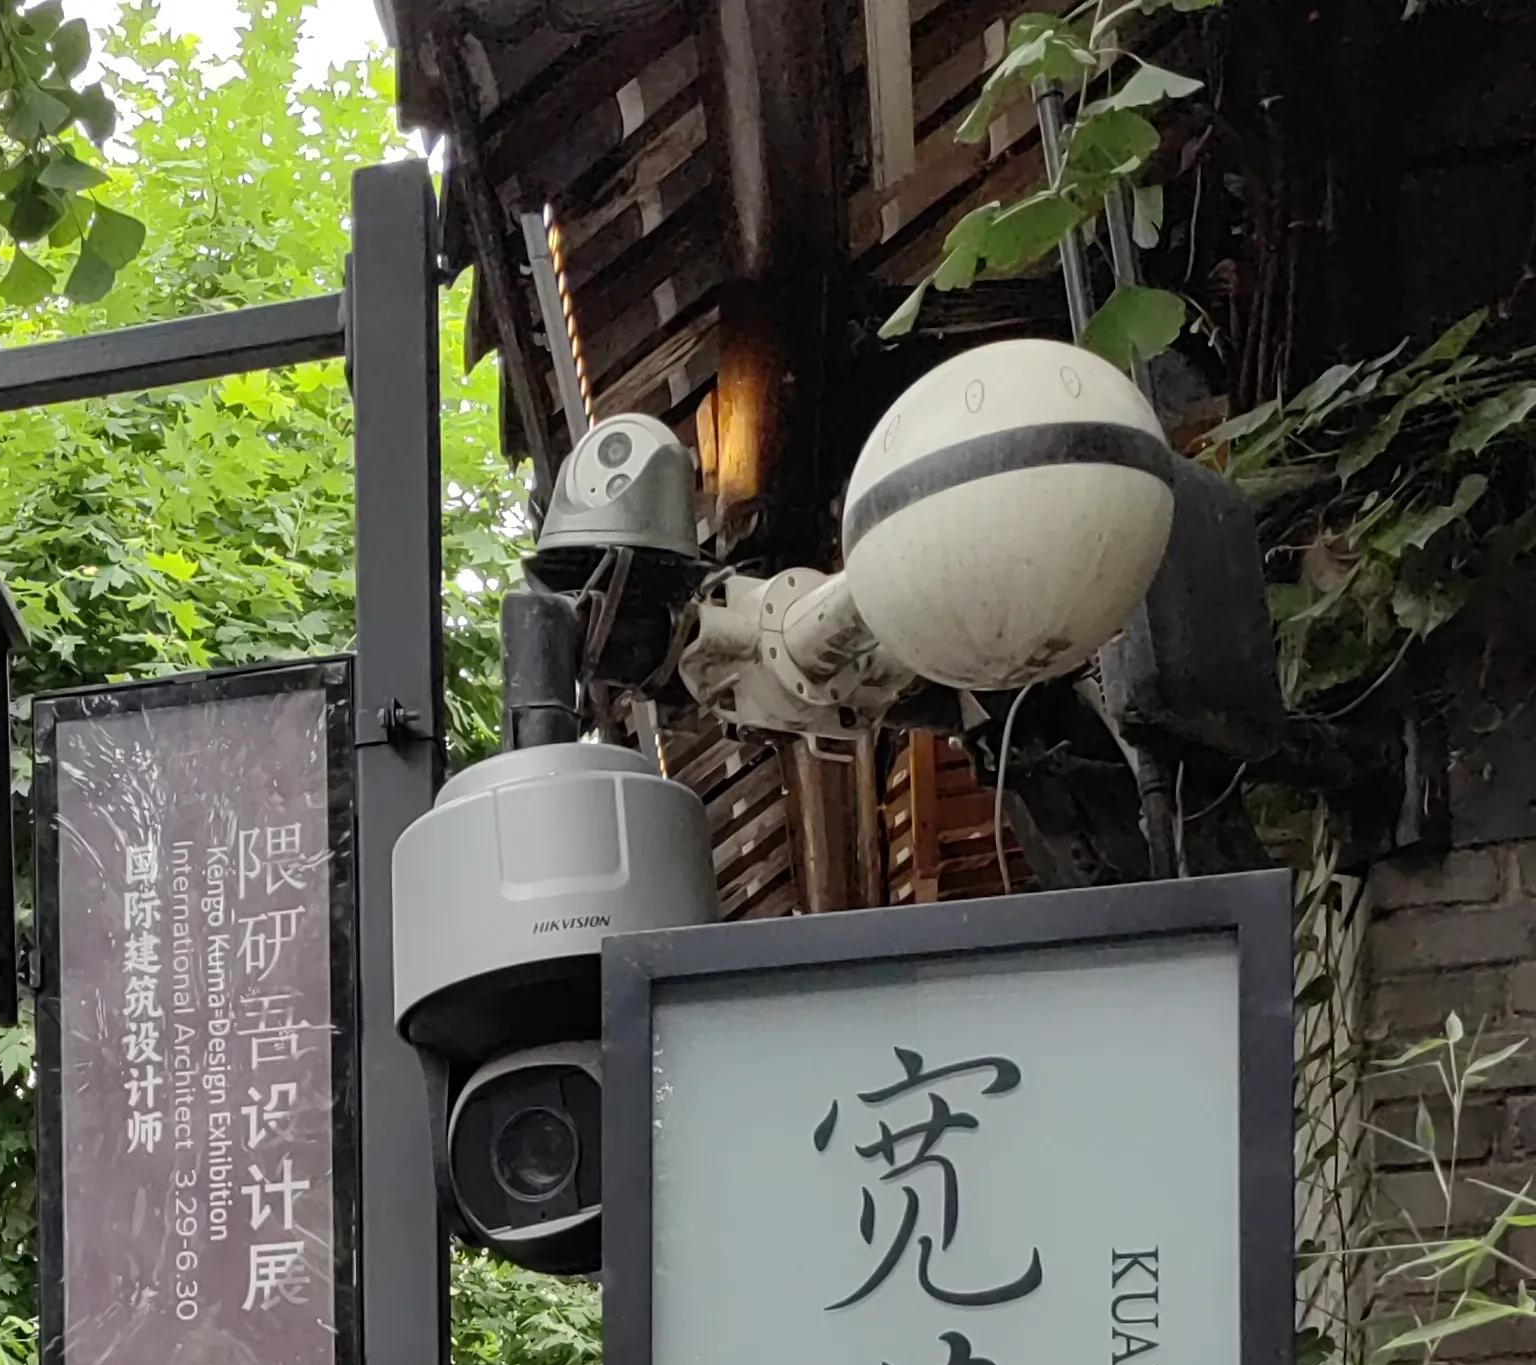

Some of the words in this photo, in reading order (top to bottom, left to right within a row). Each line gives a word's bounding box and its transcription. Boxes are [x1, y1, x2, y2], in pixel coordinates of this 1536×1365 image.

[172, 841, 193, 1013] International
[201, 847, 228, 926] Kengo
[533, 916, 611, 934] HIKVISION
[122, 844, 163, 1155] 国际建筑设计师
[203, 1019, 231, 1103] Design
[174, 1023, 194, 1150] Architect
[237, 822, 310, 1311] 隈研吾设计展
[208, 1112, 232, 1241] Exhibition
[175, 1169, 199, 1321] 3.29-6.30
